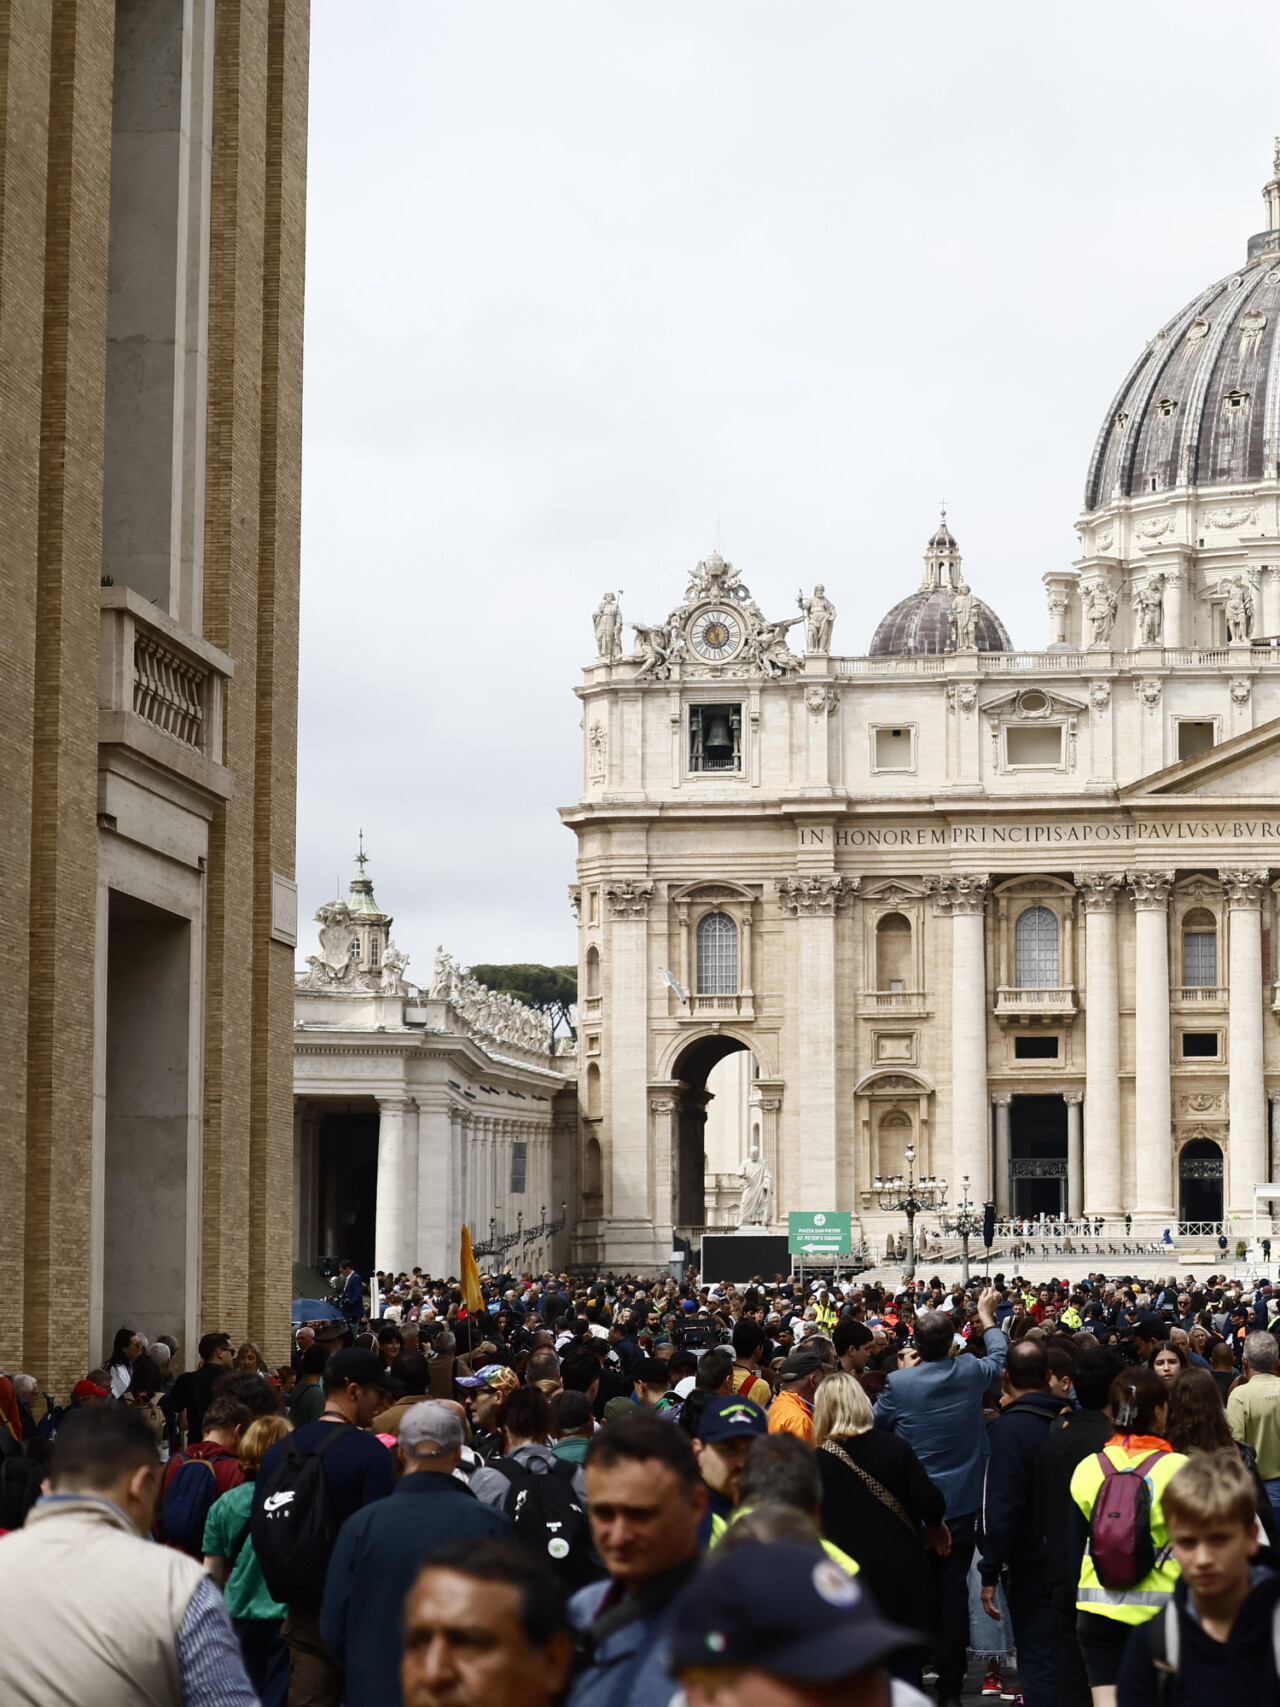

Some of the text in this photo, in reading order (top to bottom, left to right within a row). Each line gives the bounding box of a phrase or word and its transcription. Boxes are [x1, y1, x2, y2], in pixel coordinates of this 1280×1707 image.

[800, 829, 825, 845] IN
[835, 829, 947, 846] HONOREM
[952, 826, 1063, 844] PRINCIPIS
[1066, 824, 1134, 842] APOST
[1137, 822, 1210, 839] PAVLVS
[1214, 822, 1226, 838] V
[266, 1510, 290, 1519] AIR
